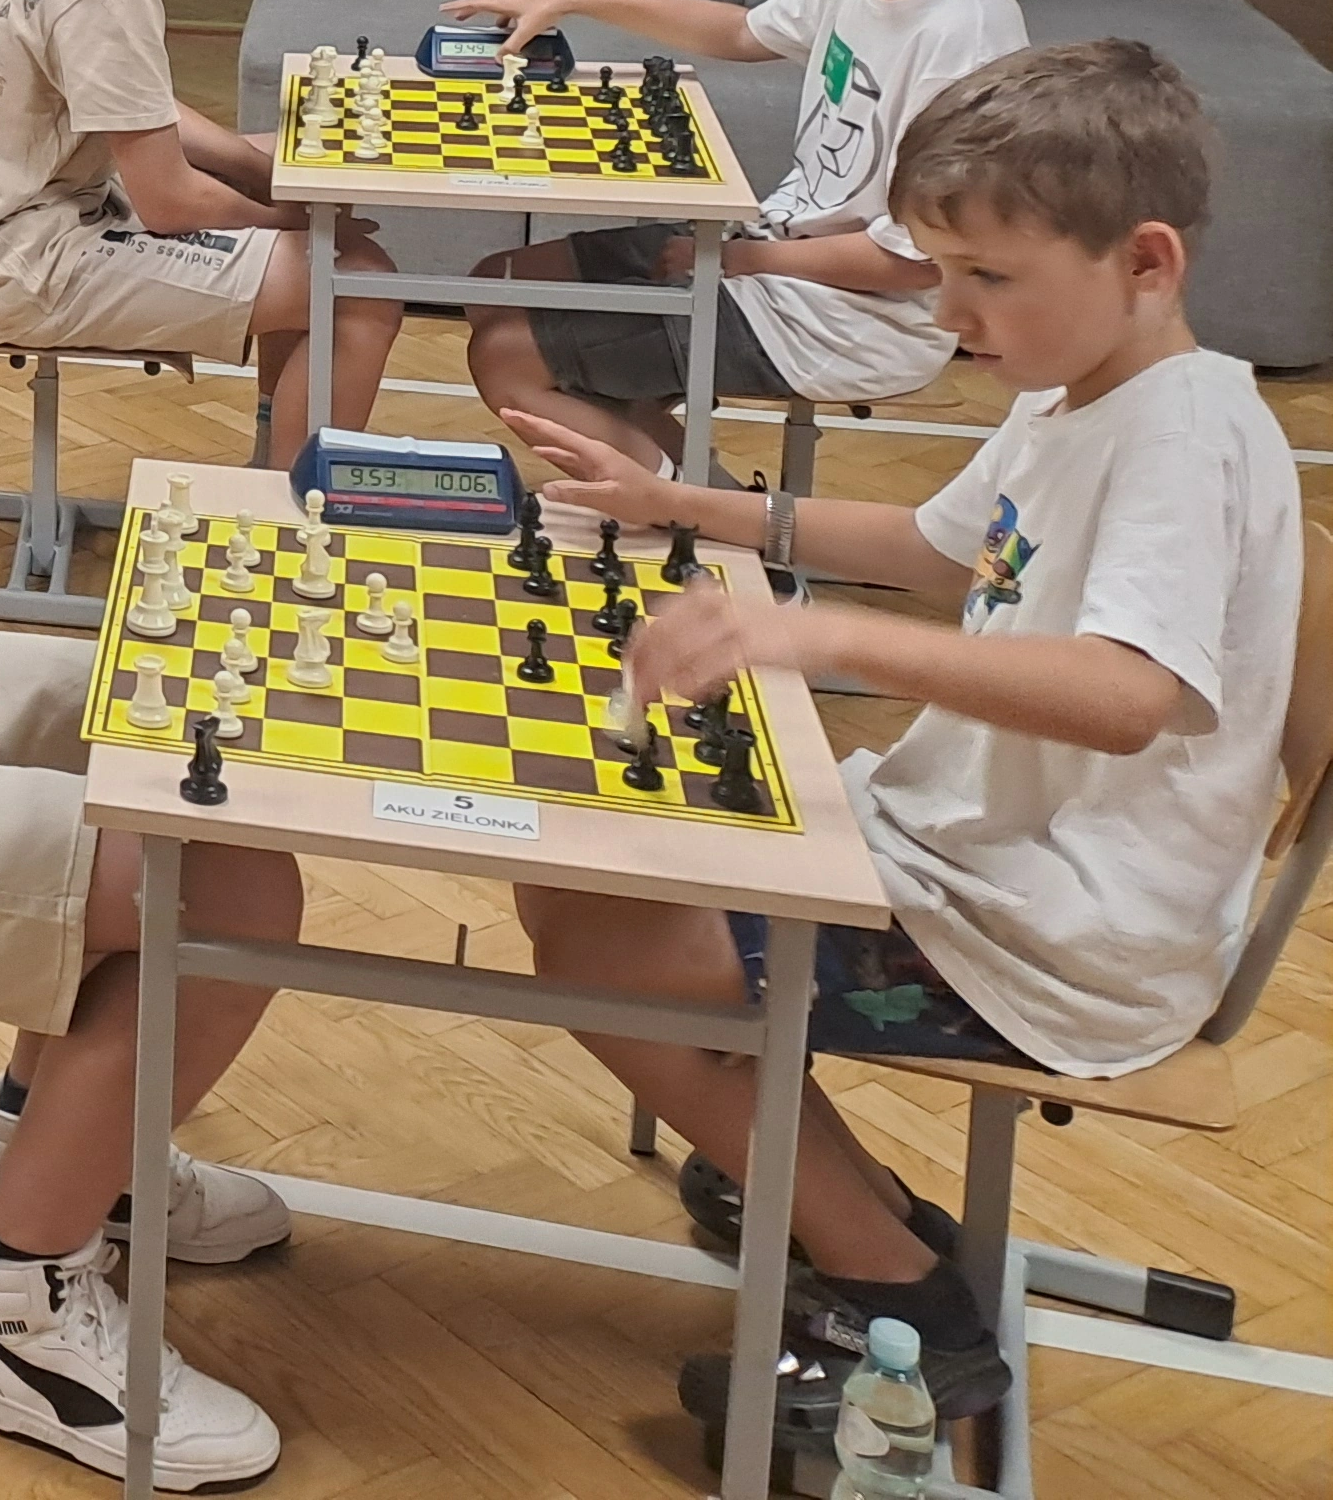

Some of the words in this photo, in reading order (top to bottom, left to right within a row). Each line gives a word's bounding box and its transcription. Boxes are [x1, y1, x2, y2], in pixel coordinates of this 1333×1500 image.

[155, 245, 225, 272] Endless
[453, 795, 475, 810] 5
[383, 803, 426, 818] AKU
[431, 808, 536, 834] ZIELONKA
